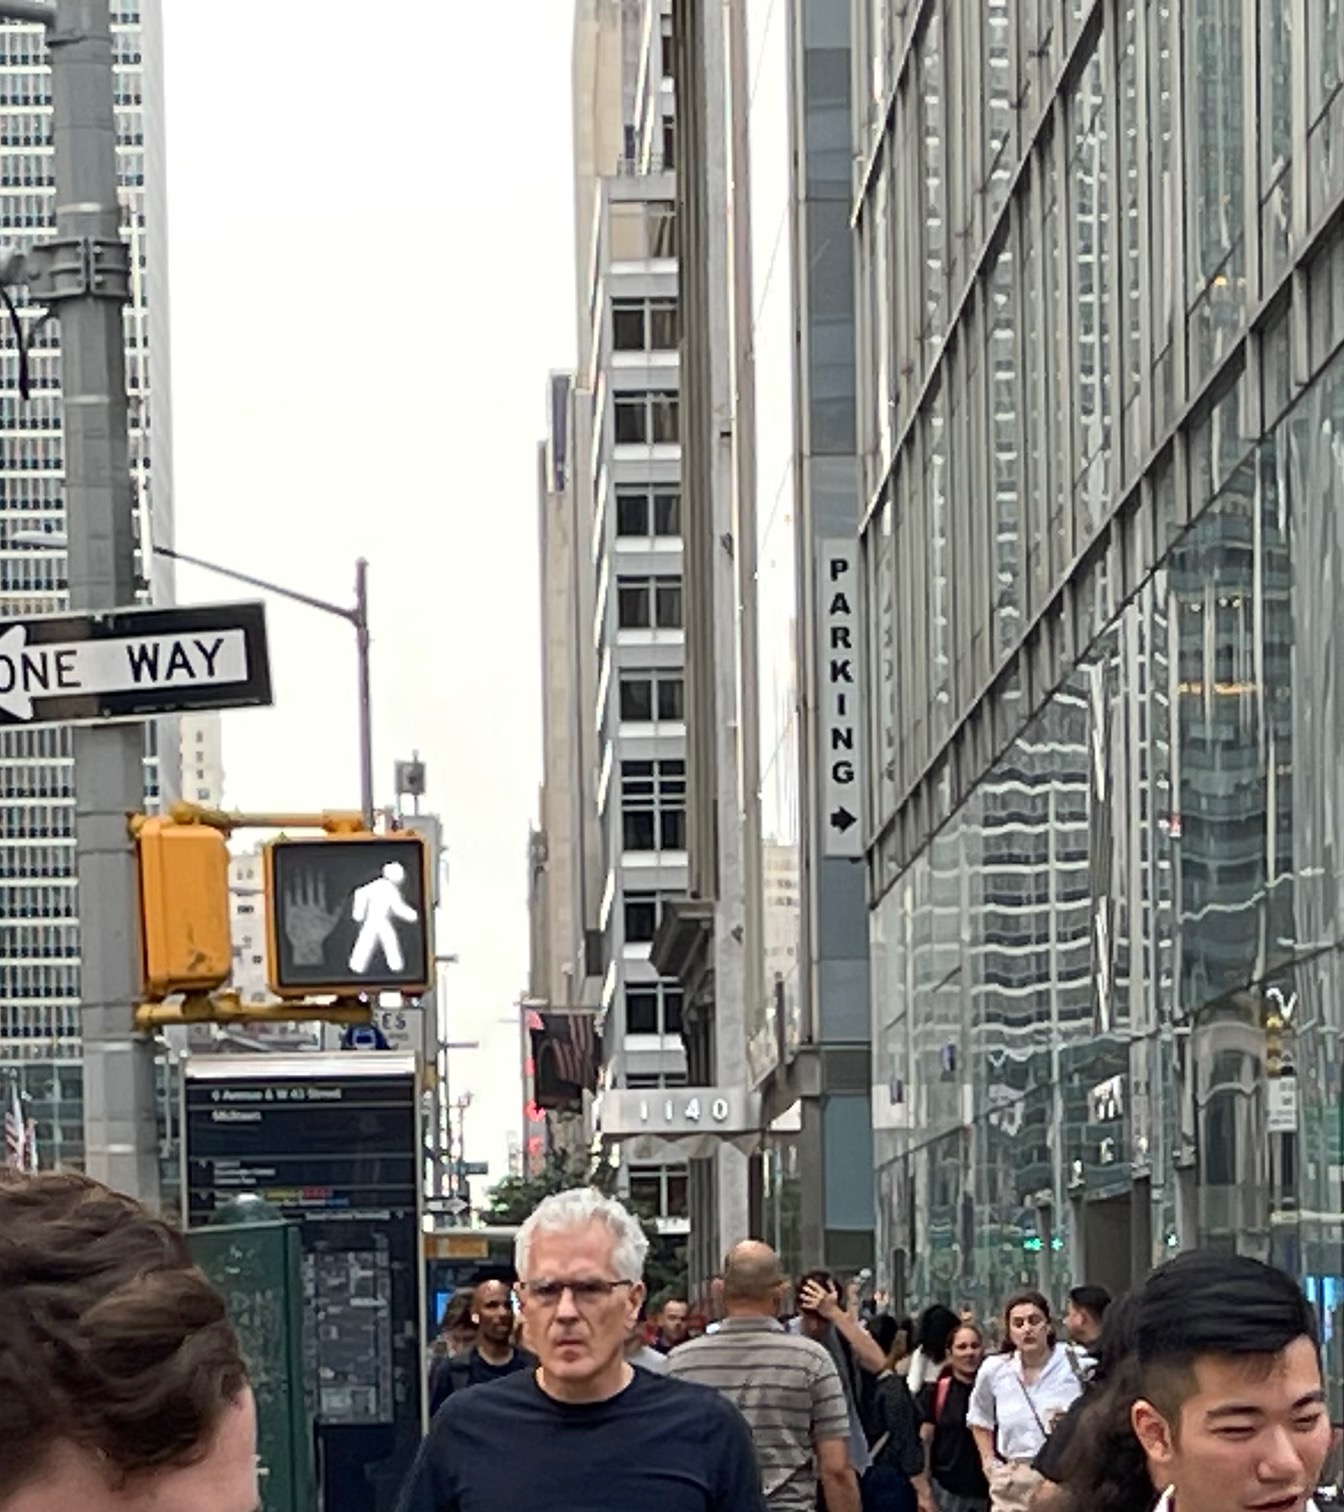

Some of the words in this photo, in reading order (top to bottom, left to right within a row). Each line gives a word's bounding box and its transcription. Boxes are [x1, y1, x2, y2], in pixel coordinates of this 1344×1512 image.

[126, 637, 225, 683] WAY
[829, 558, 856, 785] PARKING
[639, 1098, 728, 1121] 1140
